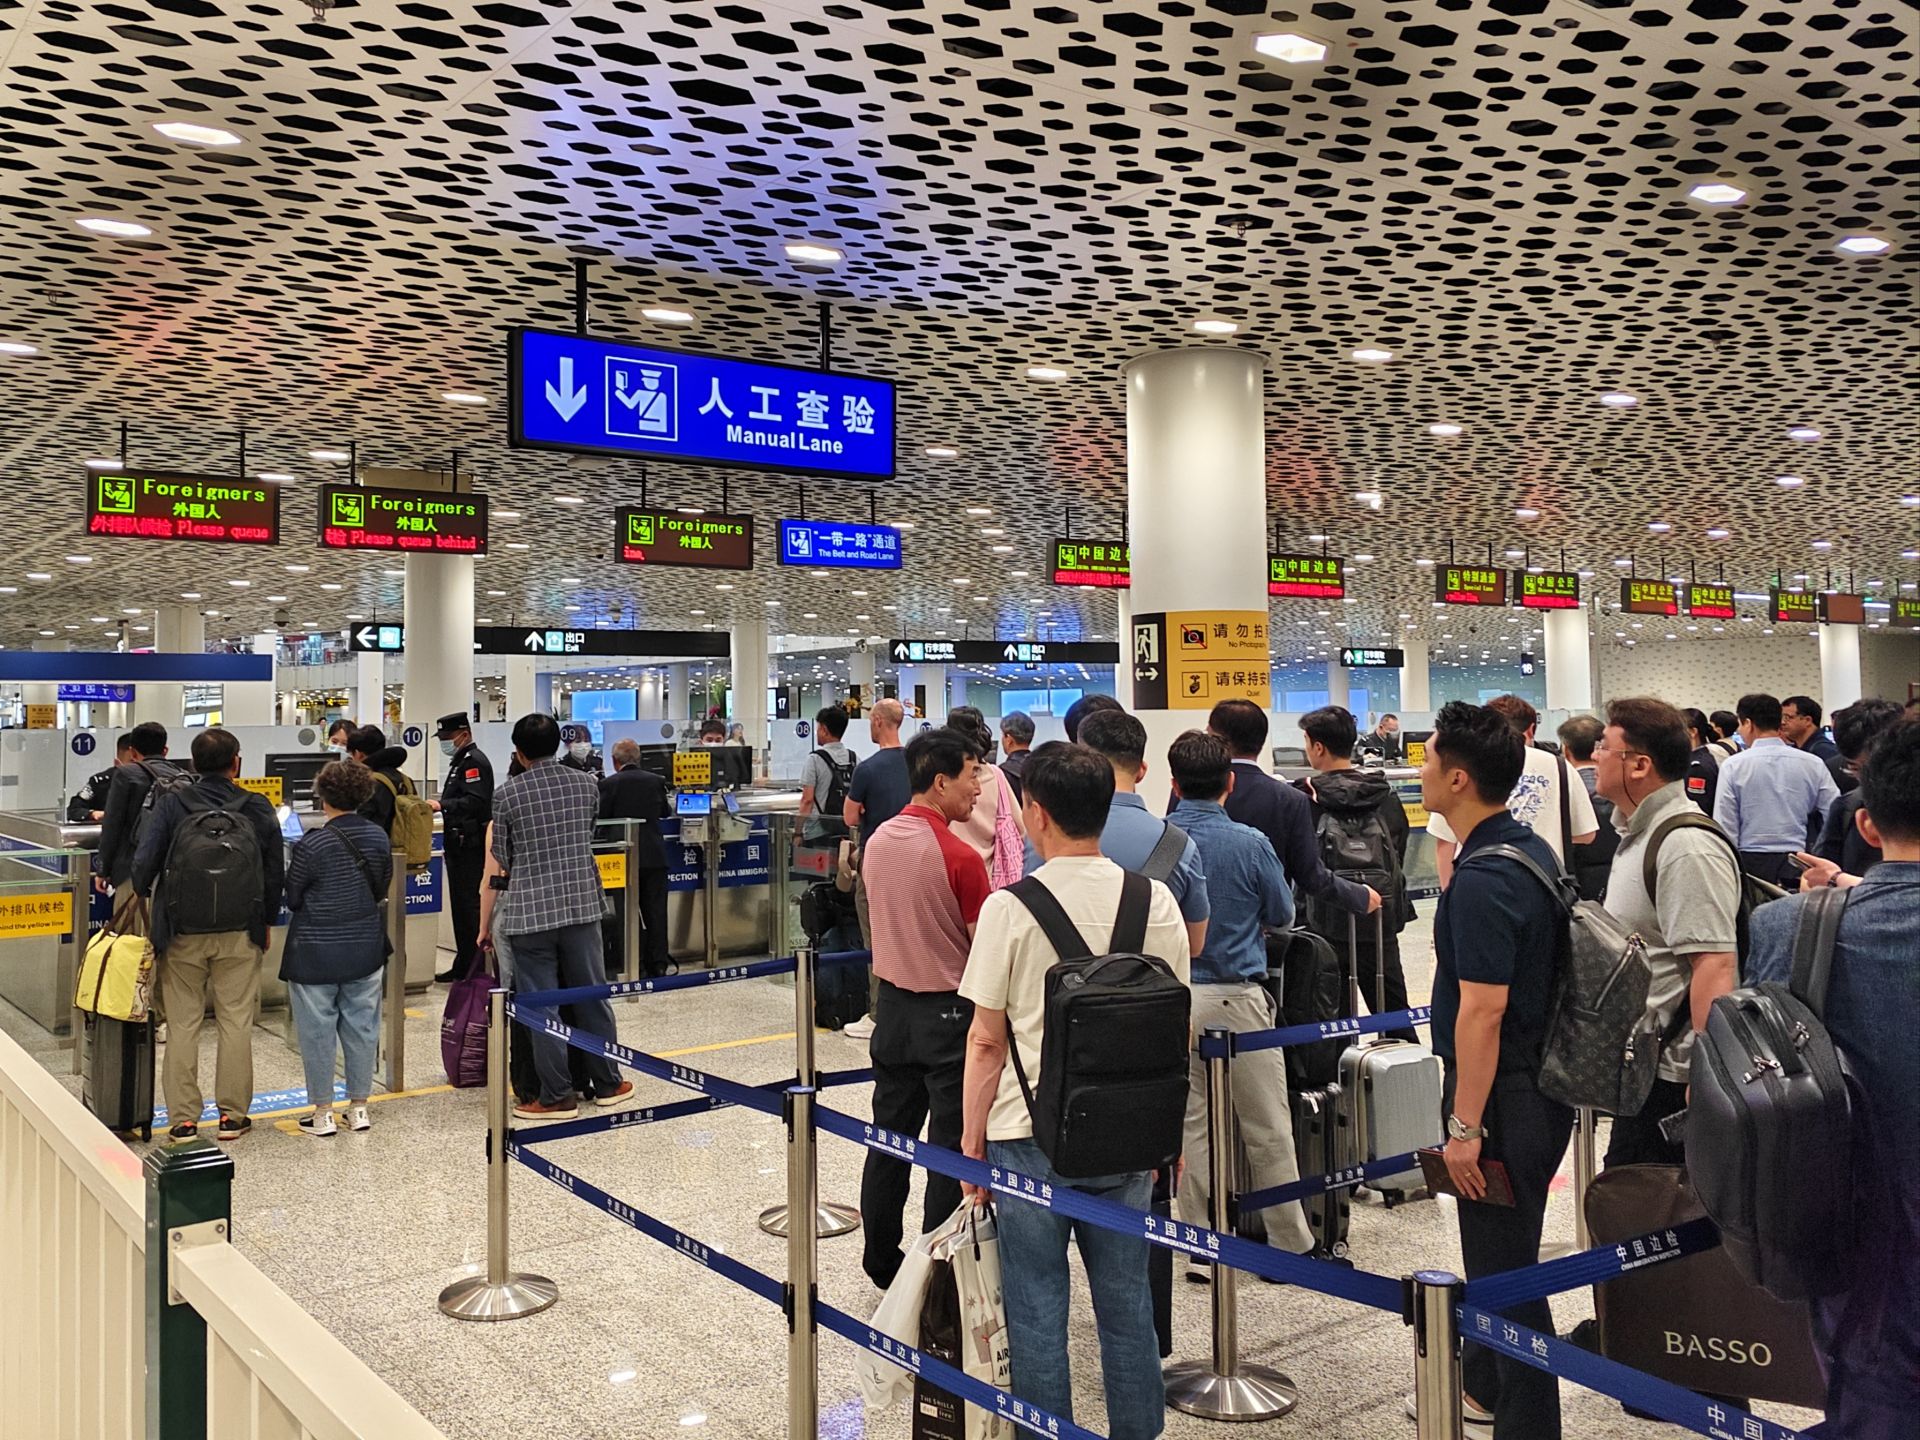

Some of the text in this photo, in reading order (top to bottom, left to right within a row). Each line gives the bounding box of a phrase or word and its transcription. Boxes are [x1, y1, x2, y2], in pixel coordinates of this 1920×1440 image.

[698, 376, 875, 434] 人工查验
[726, 424, 843, 454] Manual Lane
[143, 478, 265, 502] Foreigners
[172, 502, 221, 519] 外国人
[371, 495, 476, 516] Foreigners
[177, 520, 225, 536] Please
[230, 526, 268, 539] queue
[396, 516, 438, 532] 外国人
[659, 516, 744, 535] Foreigners
[351, 530, 393, 545] Please
[397, 535, 432, 547] queue
[436, 534, 476, 549] behind
[679, 535, 713, 549] 外国人
[818, 548, 894, 561] The Belt and Road Lane
[1288, 559, 1337, 574] 中国边检
[565, 632, 585, 644] 出口
[565, 644, 580, 652] Exit
[1521, 663, 1533, 674] 18
[777, 697, 787, 710] 17
[404, 729, 421, 743] 10
[560, 728, 576, 740] 09
[796, 724, 810, 736] 08
[74, 738, 91, 752] 11
[684, 849, 697, 865] 检
[414, 870, 432, 887] 检
[27, 921, 50, 929] yellow
[610, 981, 654, 994] 中国边检
[864, 1125, 916, 1154] 中国边检
[991, 1167, 1053, 1200] 中国边检
[1145, 1215, 1220, 1250] 中国边检
[1616, 1230, 1680, 1262] 中国边检
[869, 1330, 921, 1367] 中国边检
[1664, 1330, 1773, 1367] BASSO
[996, 1393, 1059, 1434] 中国边检
